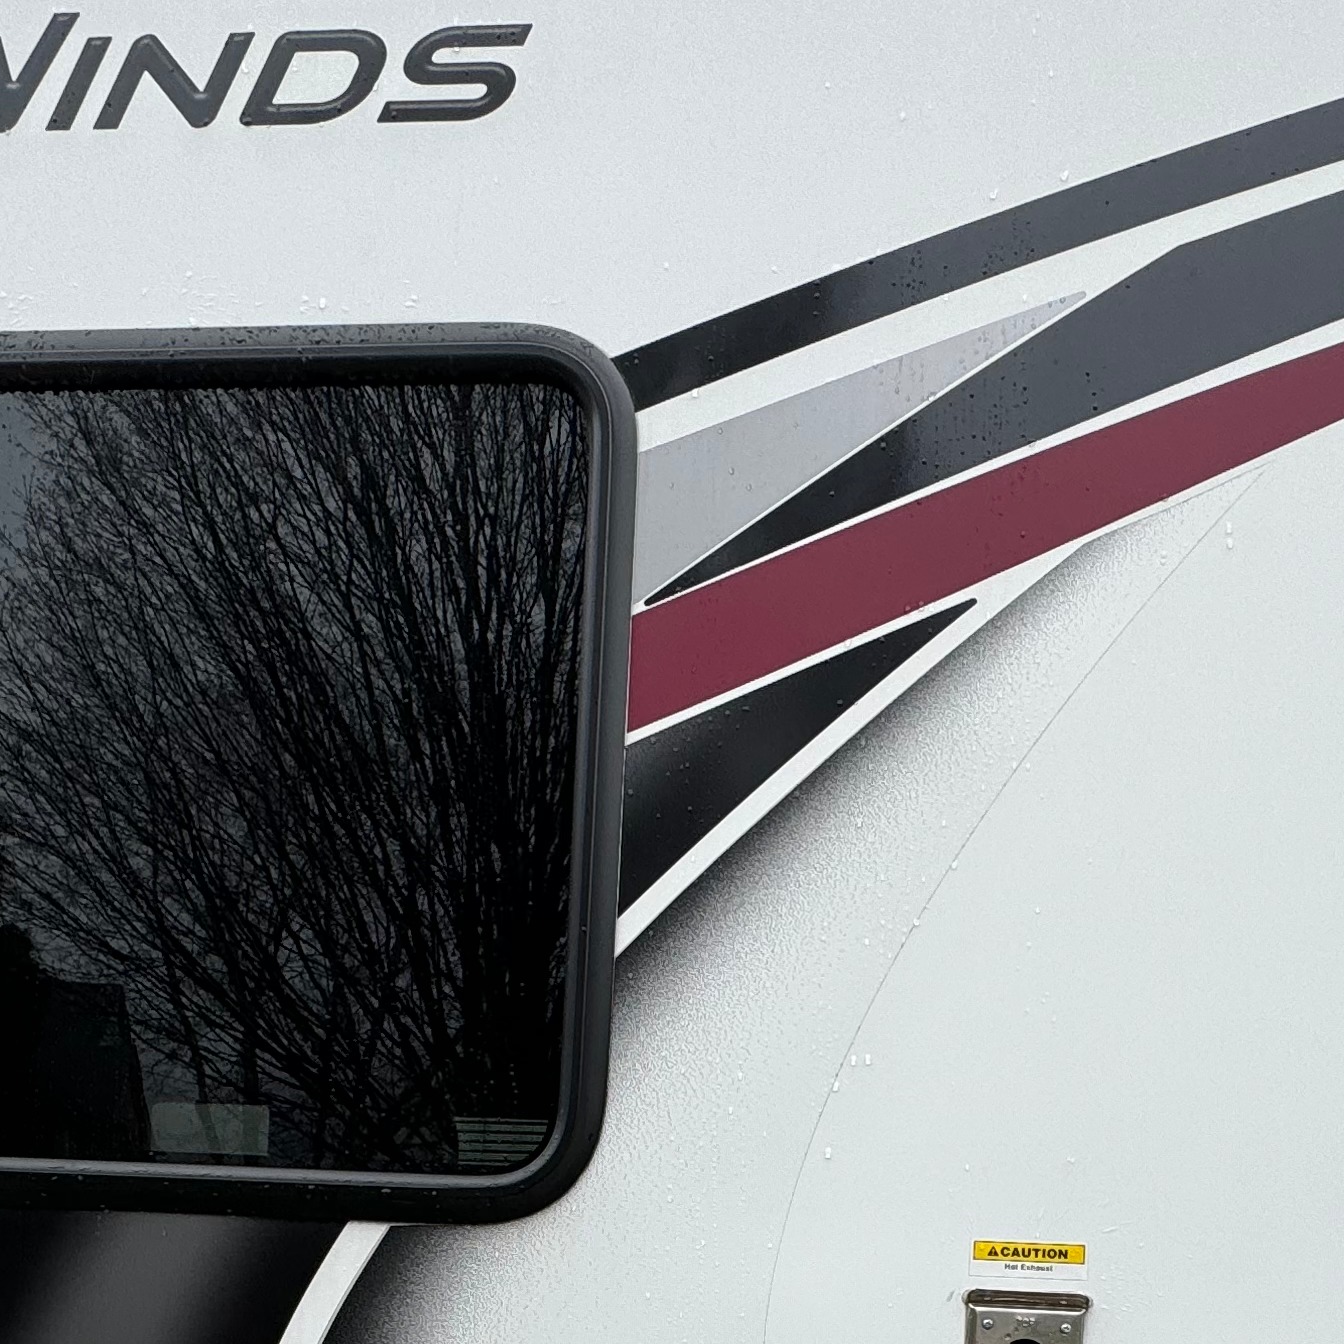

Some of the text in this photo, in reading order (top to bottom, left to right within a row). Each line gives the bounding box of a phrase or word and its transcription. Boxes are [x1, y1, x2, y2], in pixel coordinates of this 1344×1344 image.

[1000, 1247, 1068, 1260] CAUTION
[1004, 1263, 1054, 1272] Hot Exhaust
